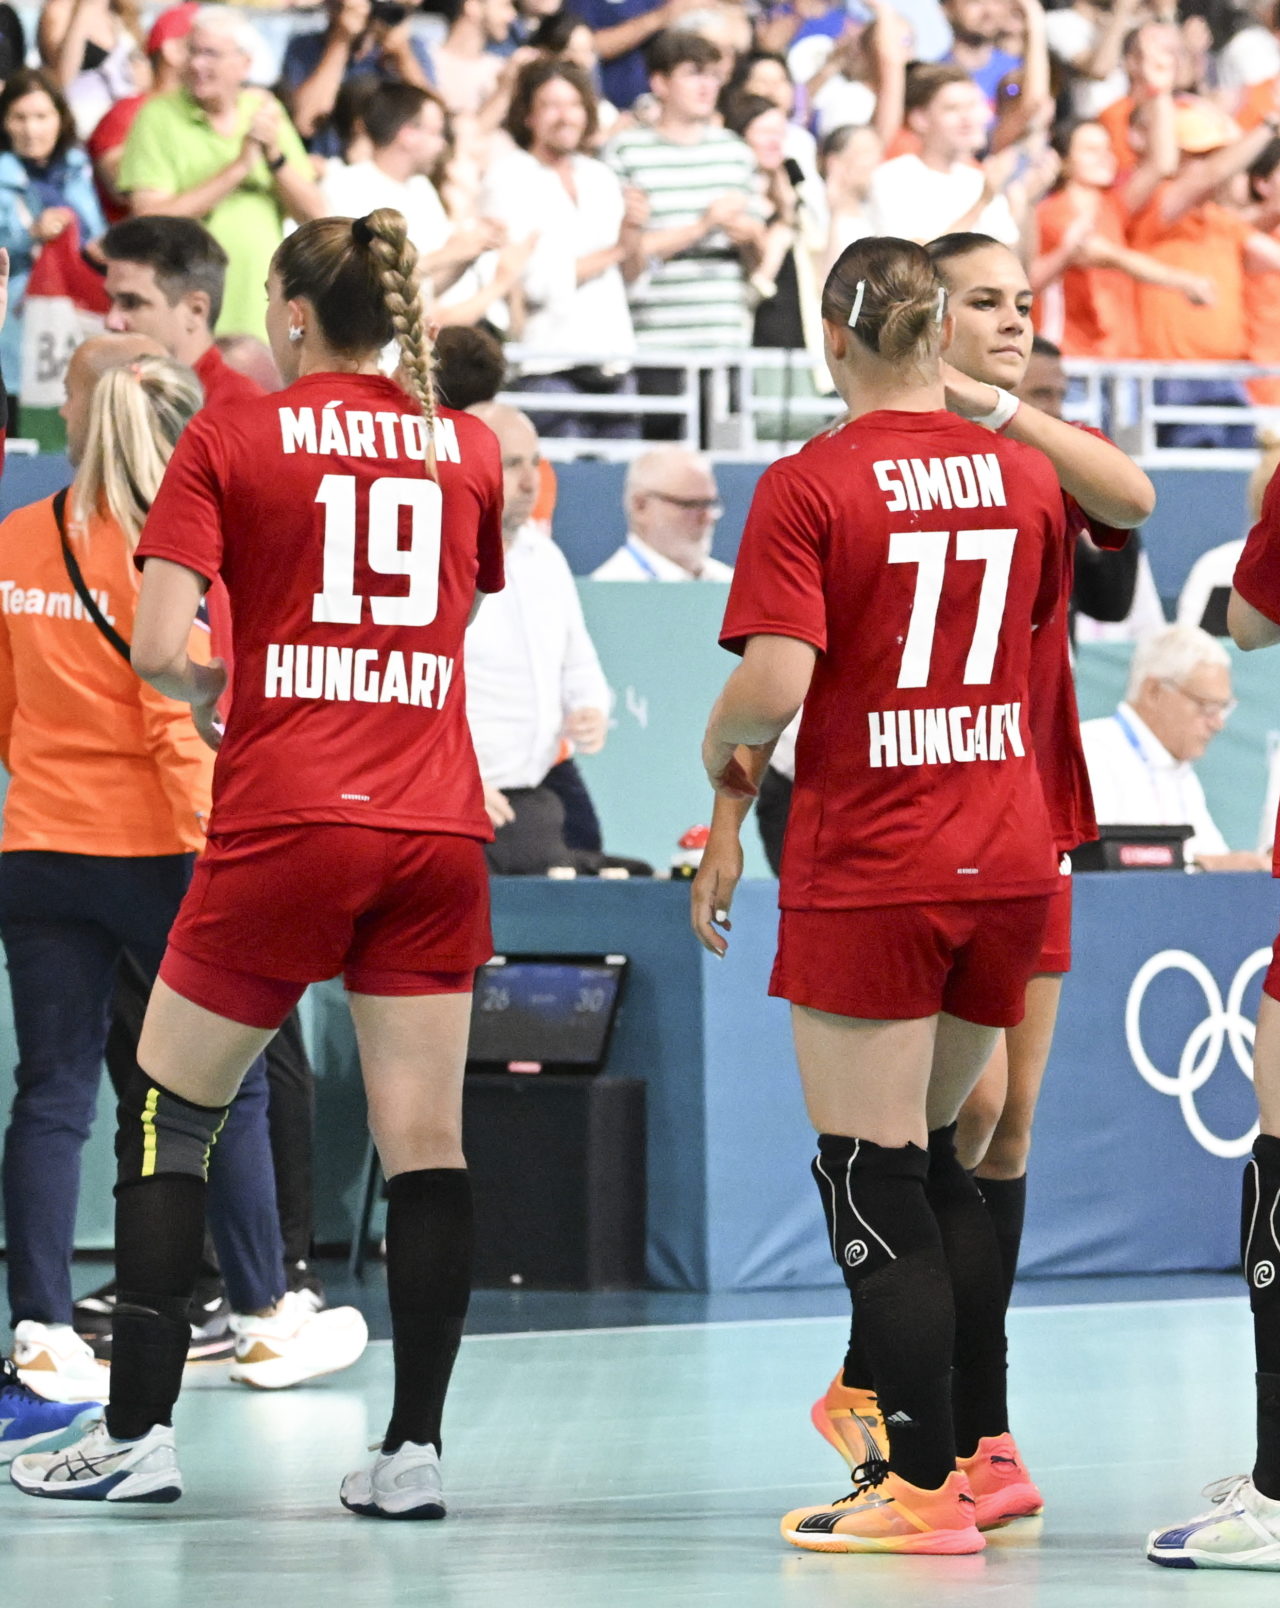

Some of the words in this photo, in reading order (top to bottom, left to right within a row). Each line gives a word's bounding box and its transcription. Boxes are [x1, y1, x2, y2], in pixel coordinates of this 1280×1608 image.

[278, 400, 461, 464] MÁRTON
[872, 453, 1007, 512] SIMON
[312, 474, 442, 627] 19
[887, 528, 1018, 689] 77
[265, 644, 454, 710] HUNGARY
